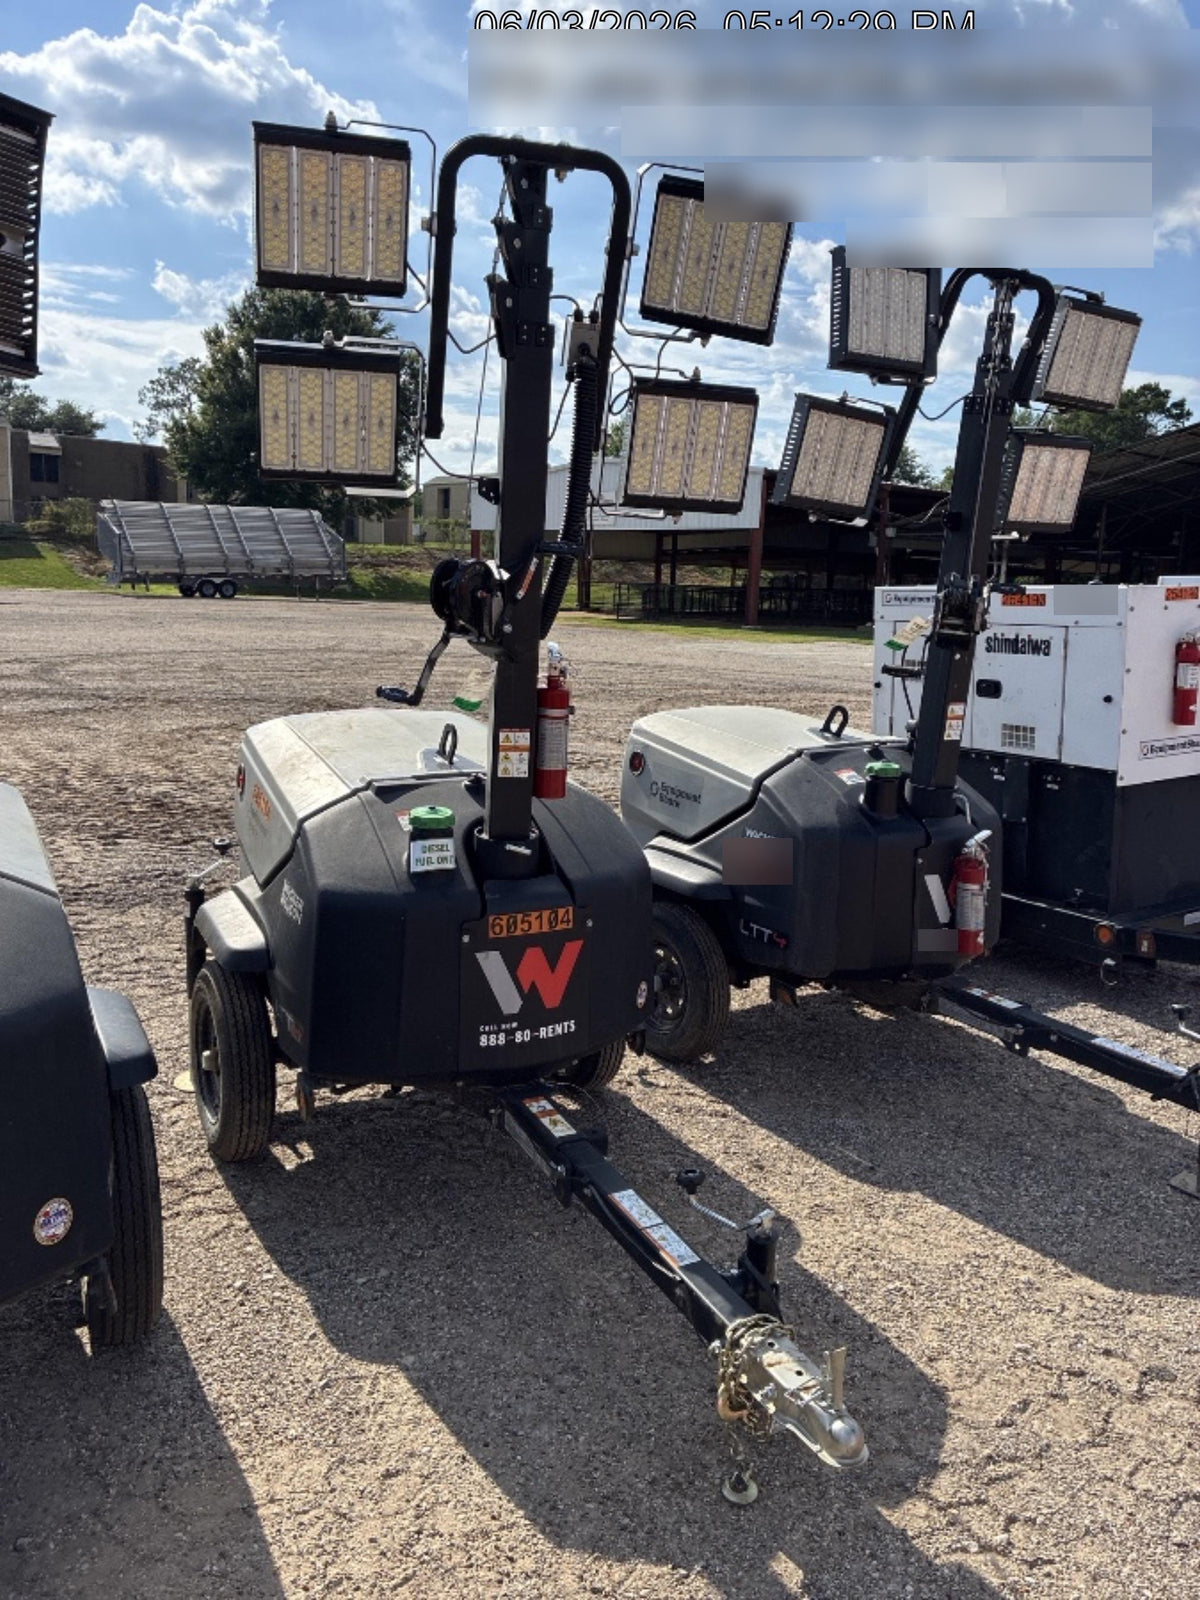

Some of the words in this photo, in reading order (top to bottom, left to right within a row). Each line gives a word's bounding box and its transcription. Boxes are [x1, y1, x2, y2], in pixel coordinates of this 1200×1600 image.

[984, 632, 1051, 657] shindaiwa
[421, 843, 450, 854] DIESEL
[491, 907, 572, 936] 605104
[739, 918, 788, 949] LTT4
[479, 1019, 576, 1047] 888-80-RENTS
